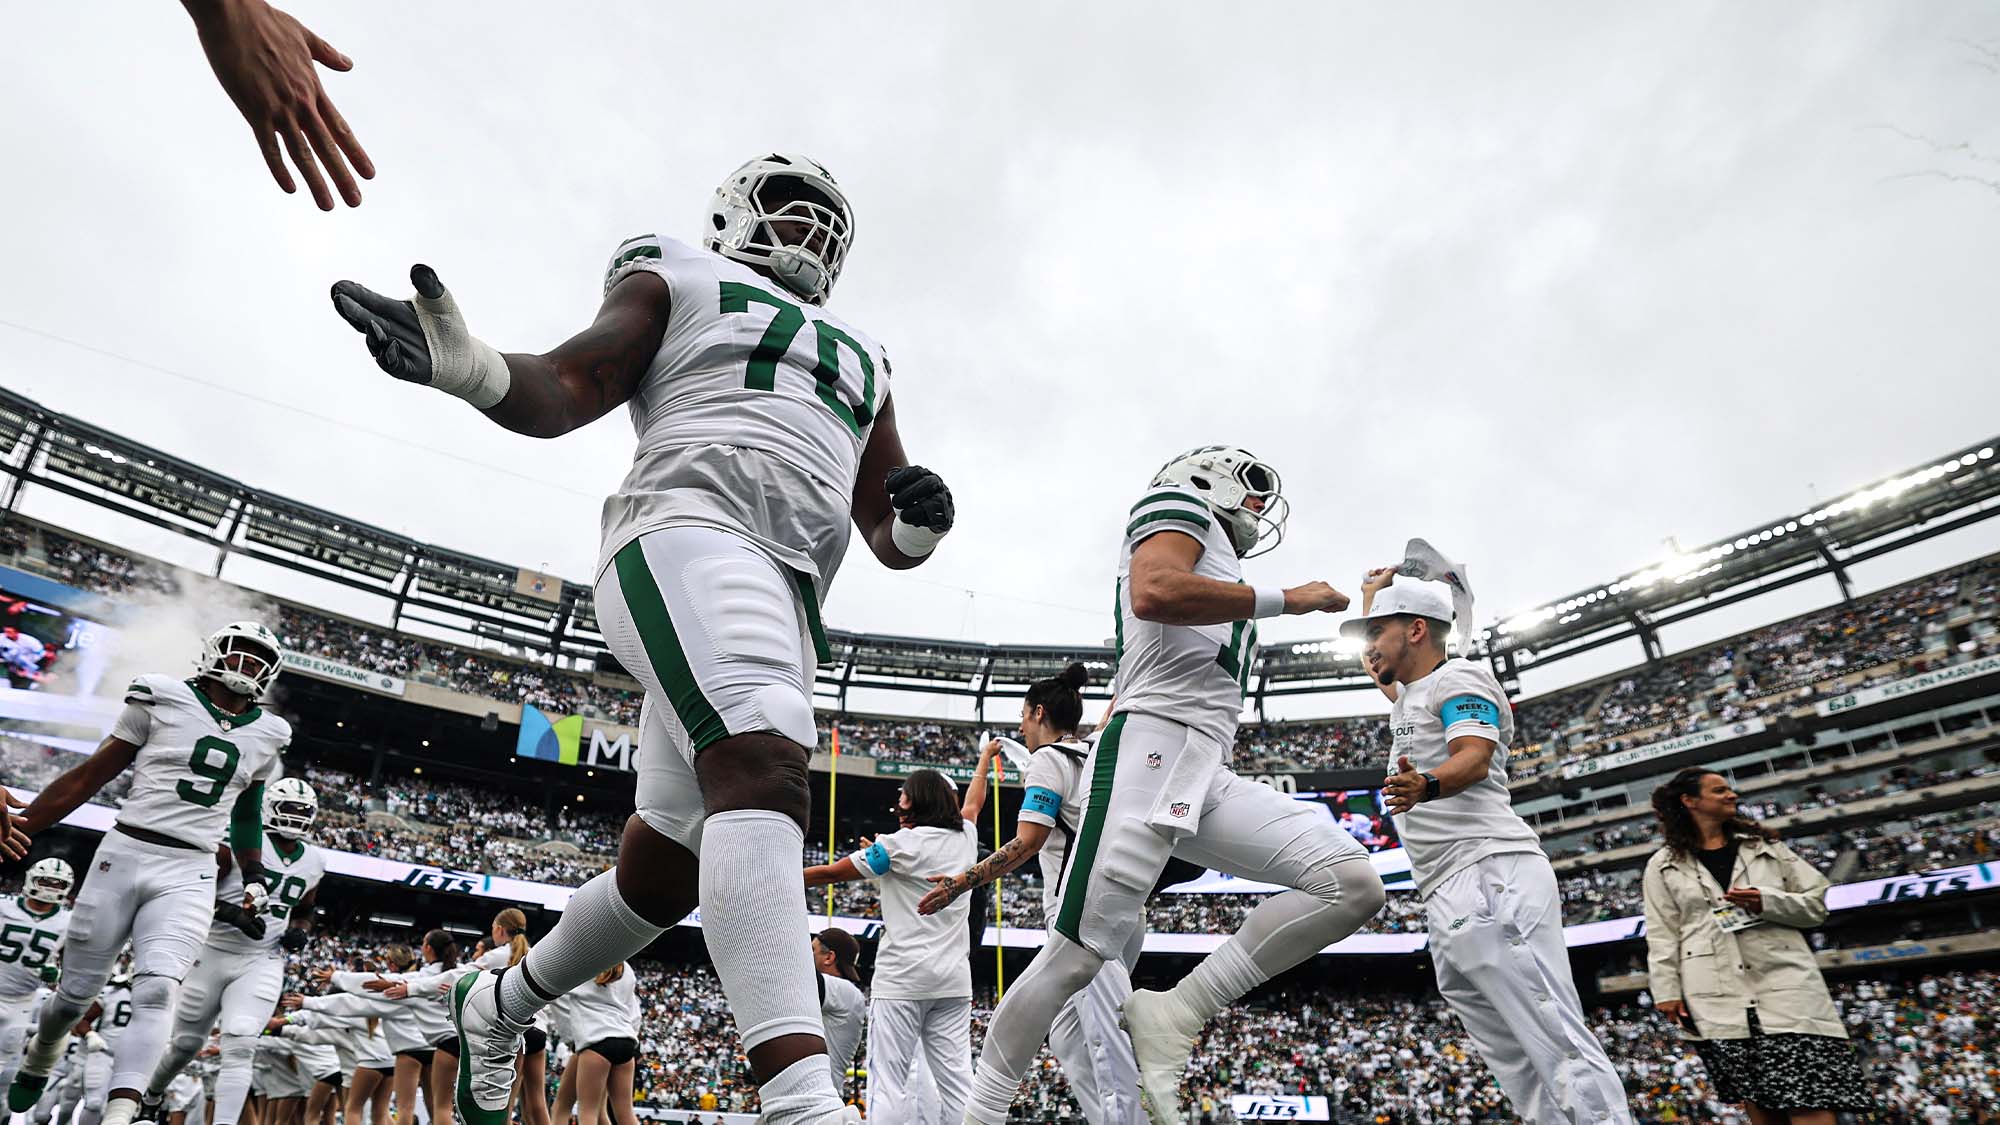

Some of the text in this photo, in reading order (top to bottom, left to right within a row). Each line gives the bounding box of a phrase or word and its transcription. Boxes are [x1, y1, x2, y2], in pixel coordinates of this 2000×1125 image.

[719, 281, 876, 440] 70
[1456, 703, 1482, 711] WEEK
[1396, 726, 1415, 736] OUT
[176, 735, 241, 808] 9
[392, 867, 479, 894] JETS
[1866, 872, 1974, 905] JETS
[0, 923, 59, 969] 55
[1240, 1100, 1300, 1116] JETS
